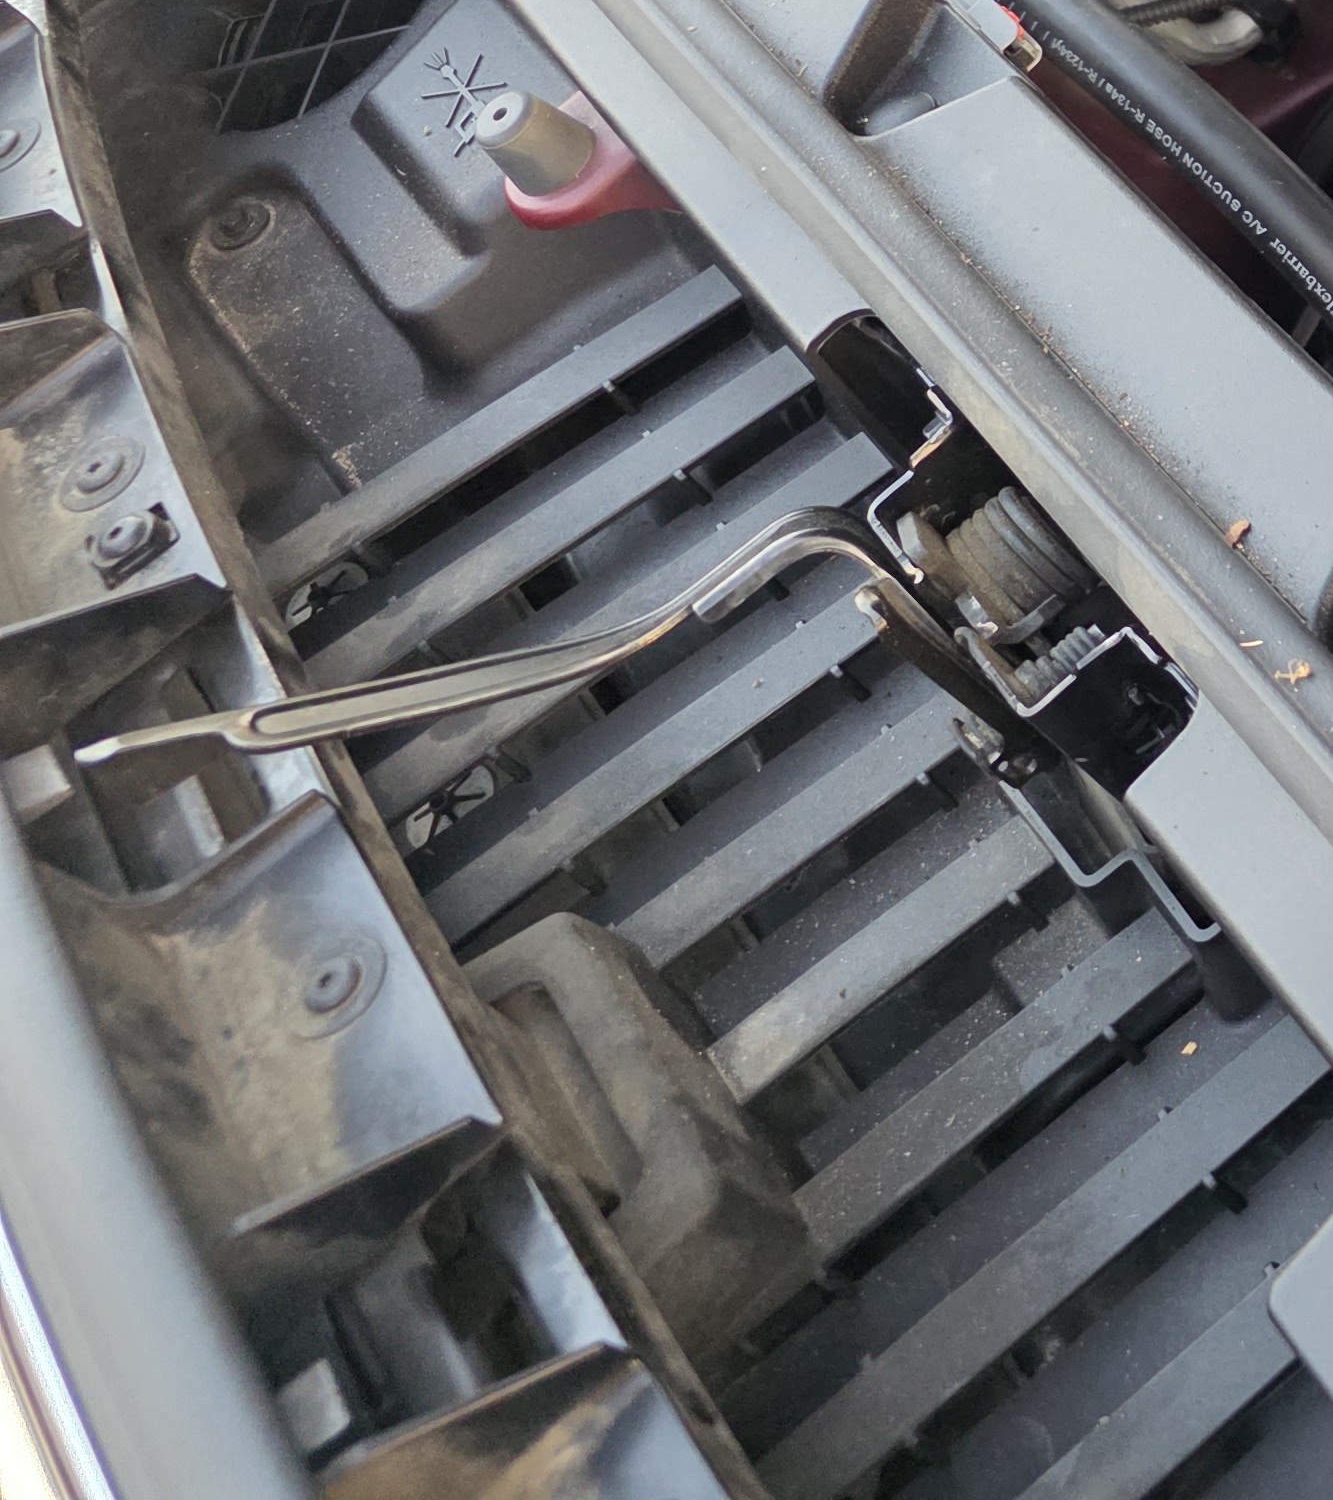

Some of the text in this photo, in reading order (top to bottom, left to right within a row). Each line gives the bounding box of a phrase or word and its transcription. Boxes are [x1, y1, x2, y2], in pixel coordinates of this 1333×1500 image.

[1141, 117, 1185, 157] HOSE
[1178, 149, 1244, 213] SUCTION
[1237, 205, 1269, 239] A/C
